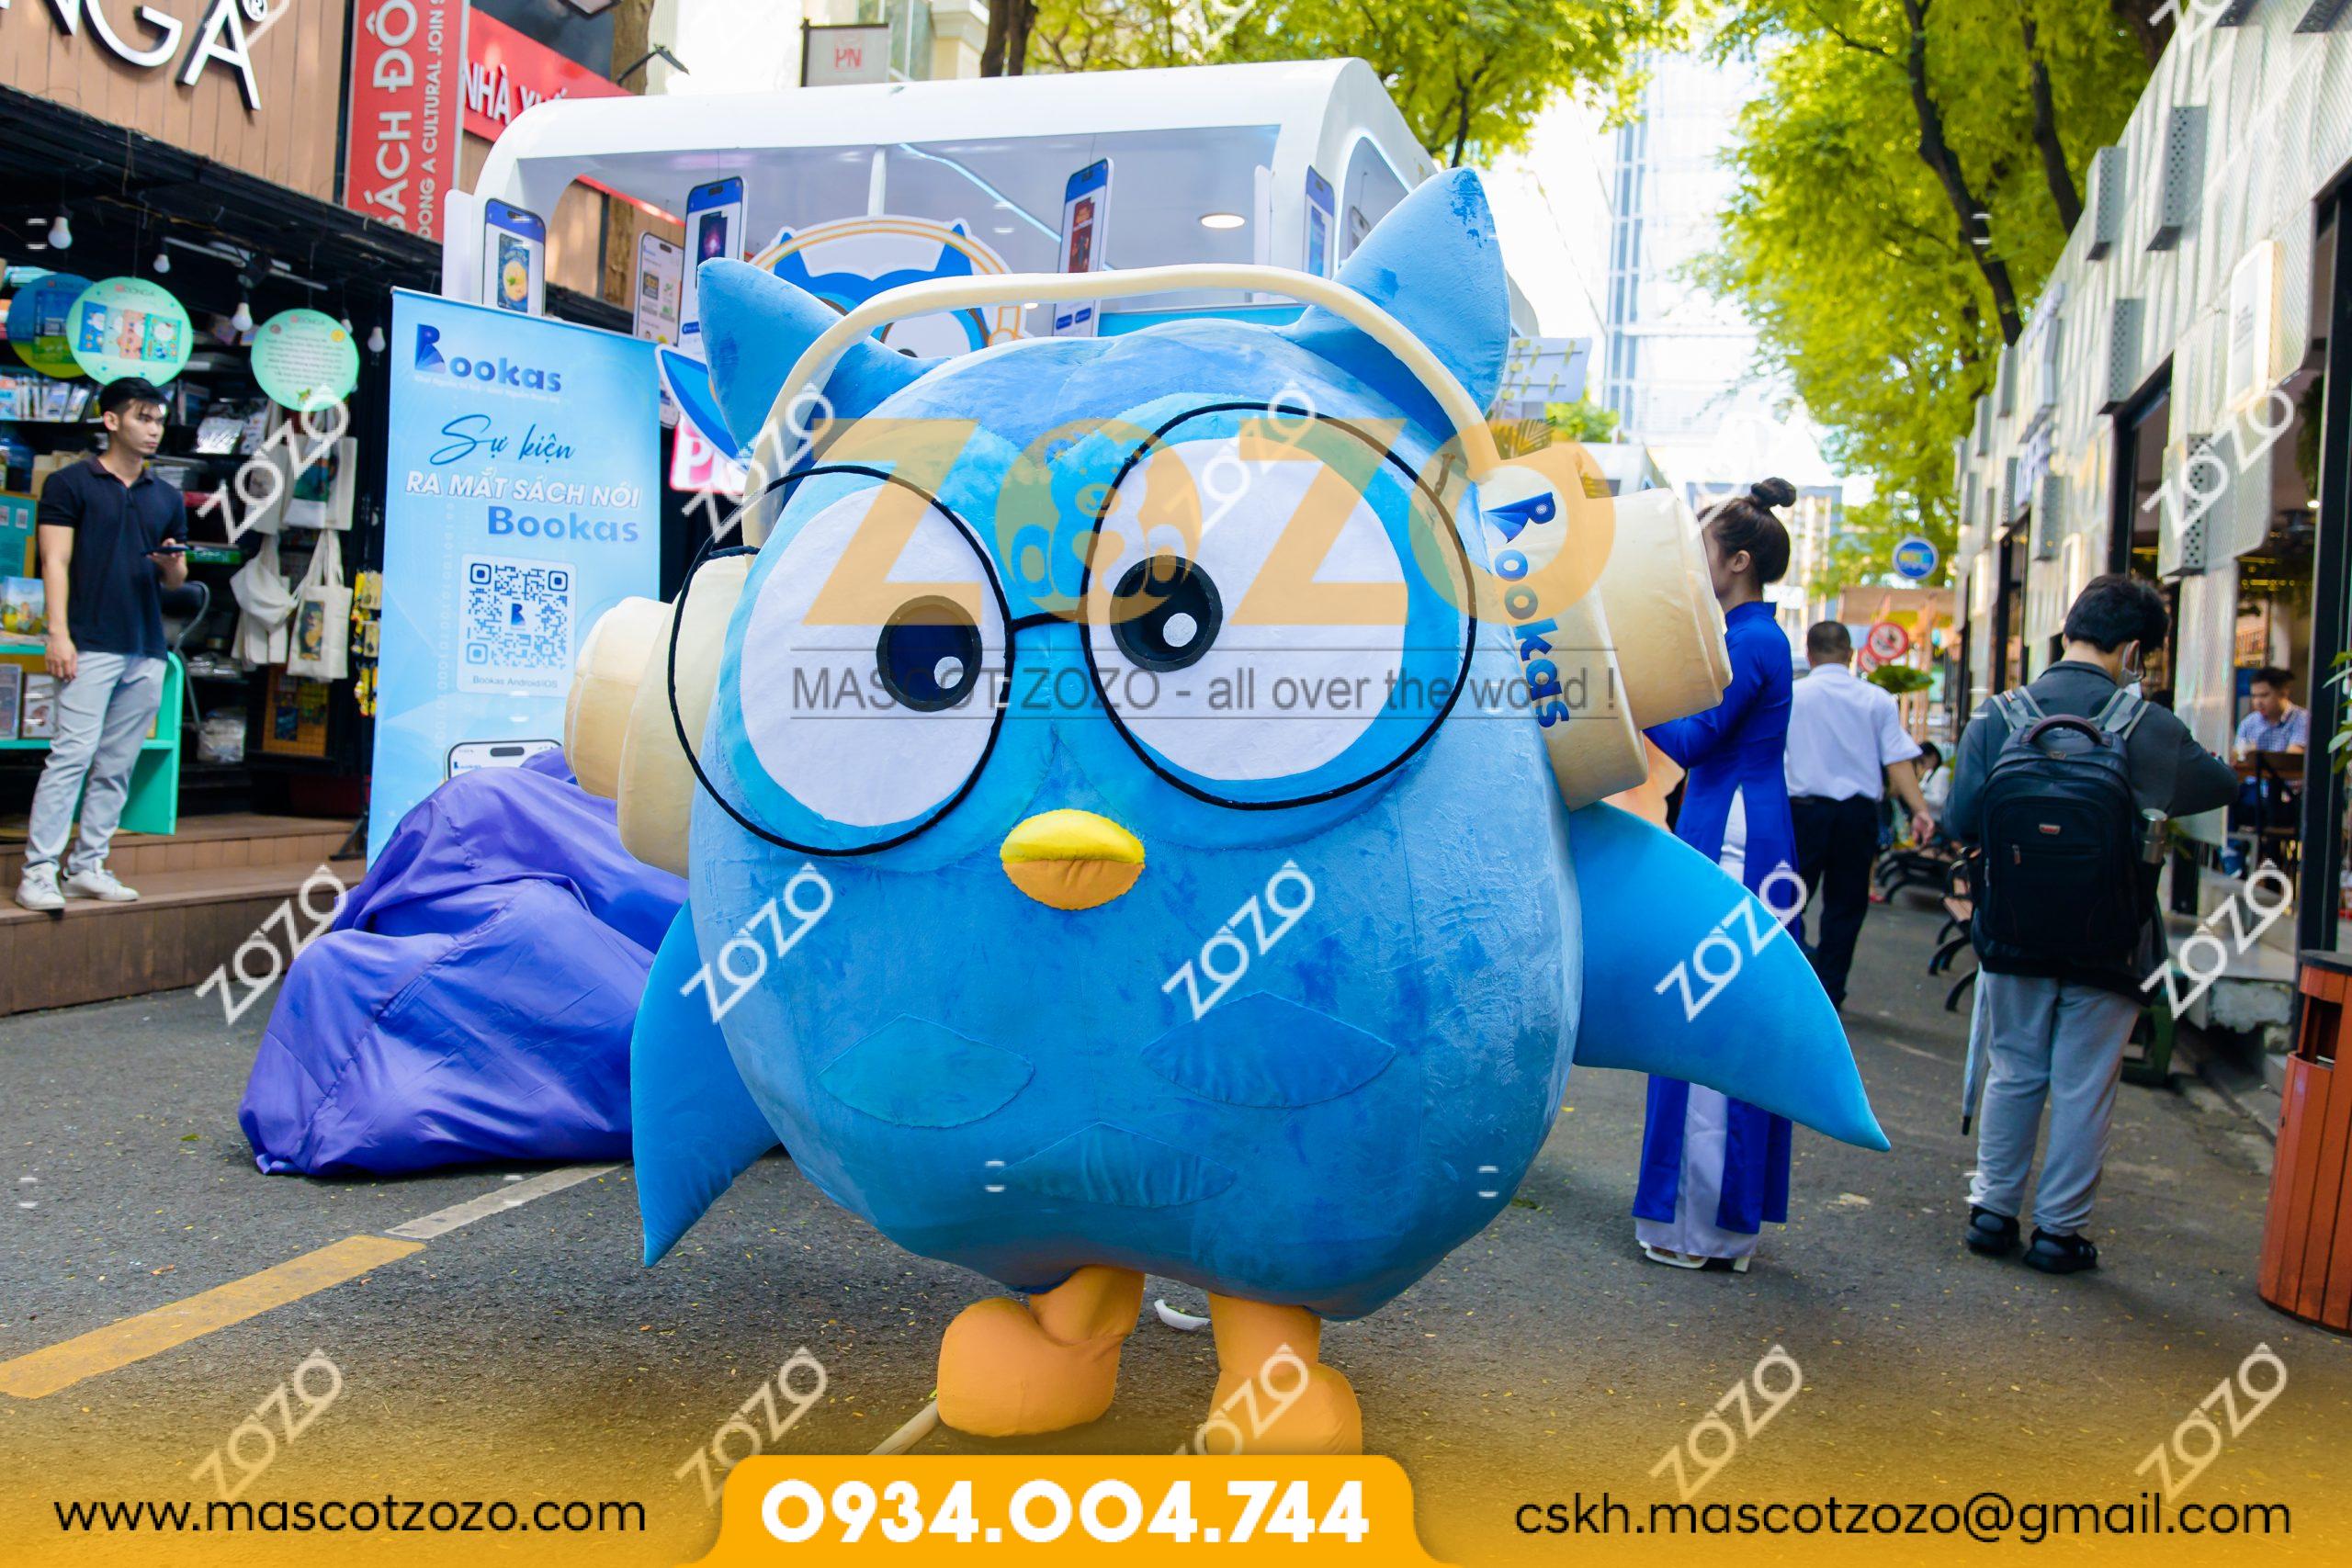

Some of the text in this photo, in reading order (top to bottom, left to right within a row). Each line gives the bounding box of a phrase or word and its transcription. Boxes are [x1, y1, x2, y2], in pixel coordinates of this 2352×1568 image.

[426, 9, 446, 56] JOIN
[422, 60, 442, 154] CULTURAL
[462, 59, 511, 125] NHÀ
[421, 157, 436, 175] A
[414, 323, 561, 393] Bookas
[519, 423, 575, 464] kiện
[406, 467, 640, 508] RA MẮT SÁCH NÓI
[488, 505, 639, 543] Bookas
[1479, 491, 1568, 728] Bookas
[473, 675, 503, 685] Bookas
